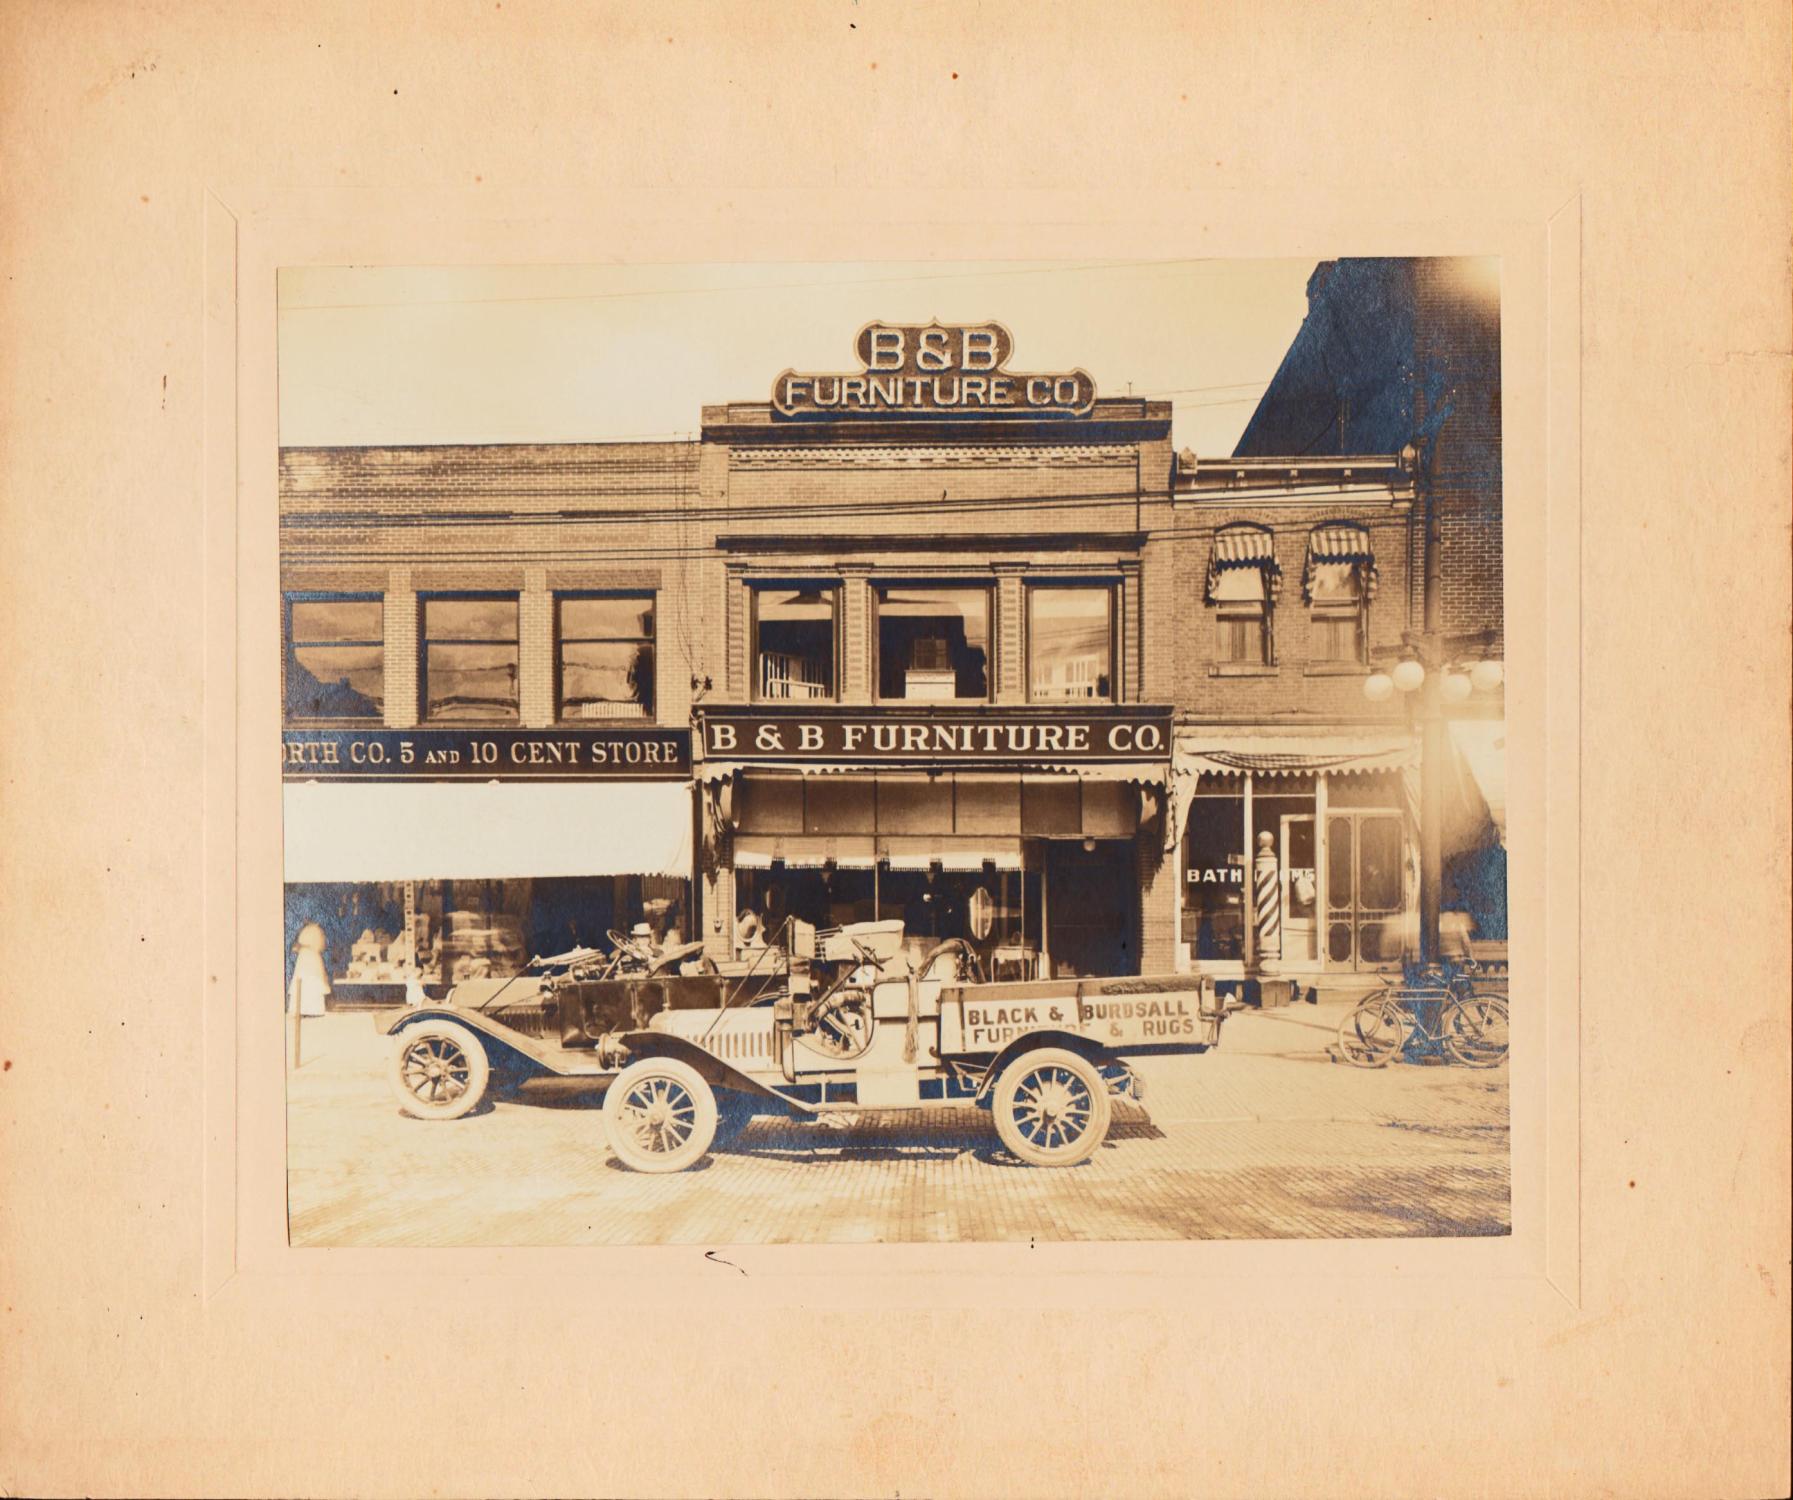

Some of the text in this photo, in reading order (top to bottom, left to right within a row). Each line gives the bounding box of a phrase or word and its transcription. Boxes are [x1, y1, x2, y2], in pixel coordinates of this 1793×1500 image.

[870, 328, 999, 372] B & B
[785, 377, 1080, 407] FURNITURE CO
[711, 723, 1165, 751] B & B FURNITURE CO.
[351, 741, 392, 764] CO.
[400, 741, 415, 764] 5
[425, 750, 461, 764] AND
[470, 741, 498, 764] 10
[510, 741, 581, 764] CENT
[591, 741, 679, 764] STORE
[1187, 868, 1243, 883] BATH
[968, 1000, 1190, 1026] BLACK & BURDSALL
[1109, 1021, 1124, 1038] &
[1142, 1018, 1195, 1037] RUGS
